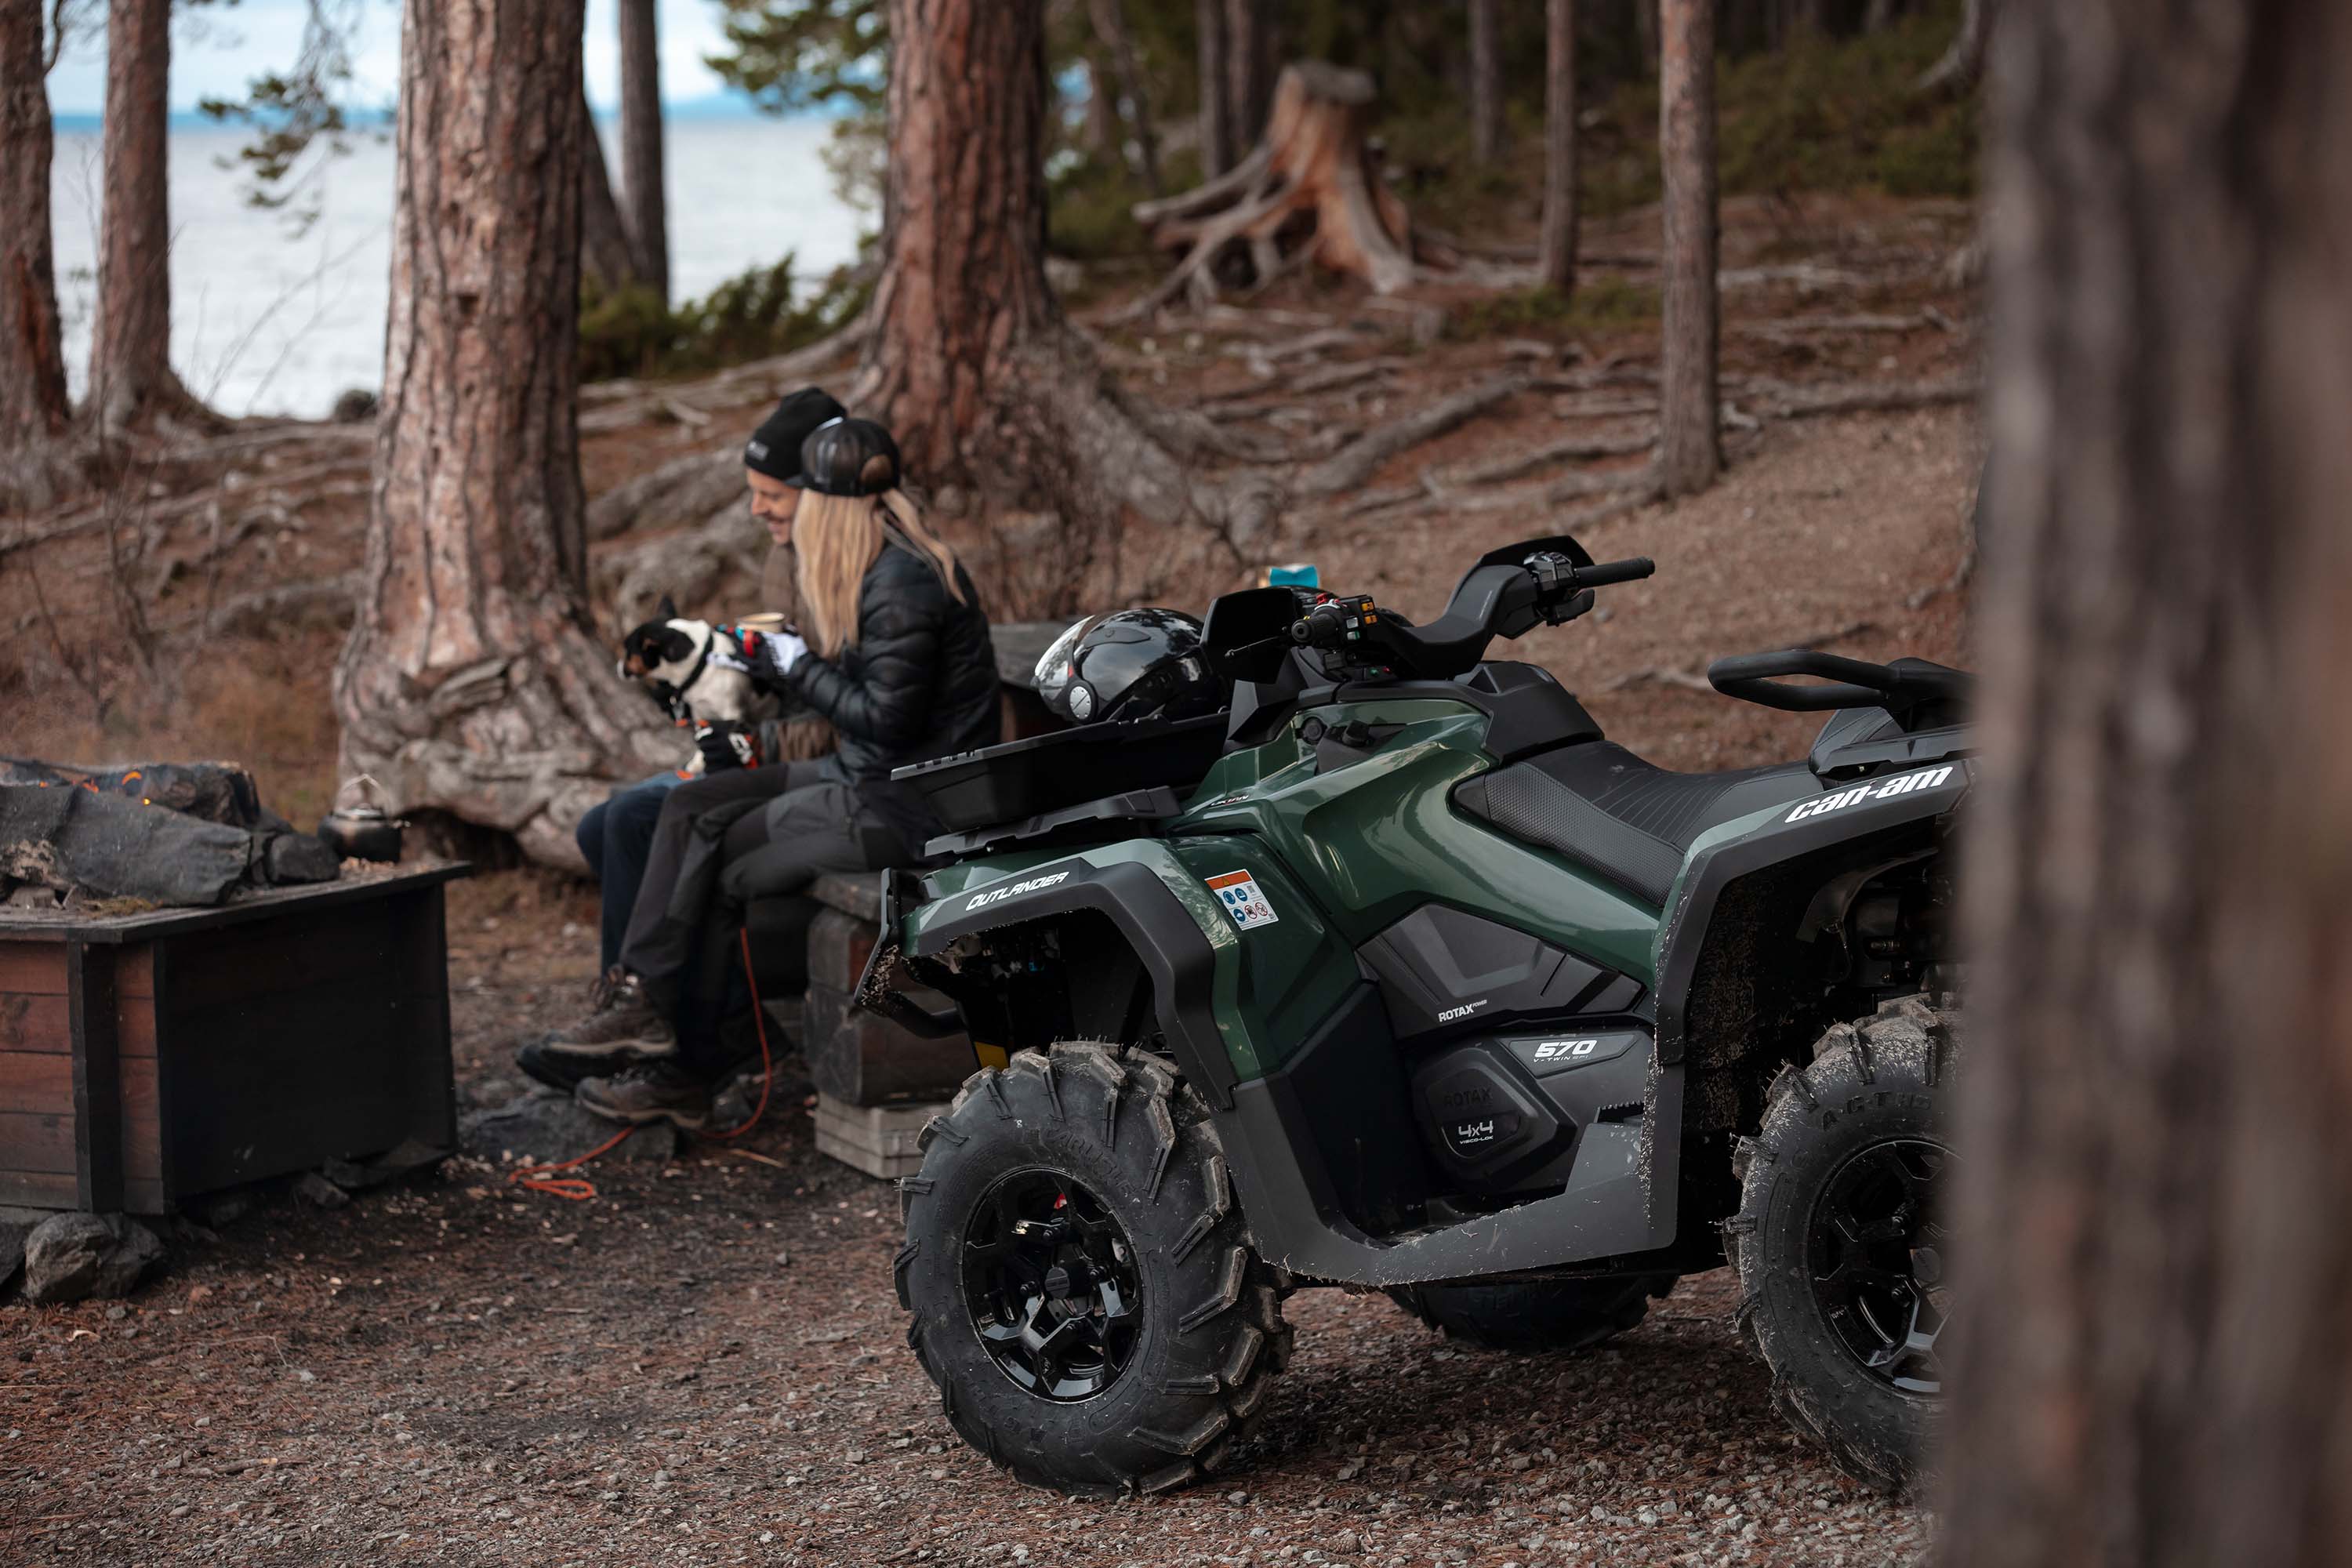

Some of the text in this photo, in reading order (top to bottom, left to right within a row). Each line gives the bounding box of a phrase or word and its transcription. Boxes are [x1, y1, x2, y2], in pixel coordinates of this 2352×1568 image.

[965, 871, 1069, 911] OUTLANDER
[1438, 1004, 1474, 1022] ROTAX
[1534, 1040, 1597, 1058] 570
[1458, 1120, 1494, 1138] 4x4
[1459, 1134, 1494, 1145] VISCO-LOK
